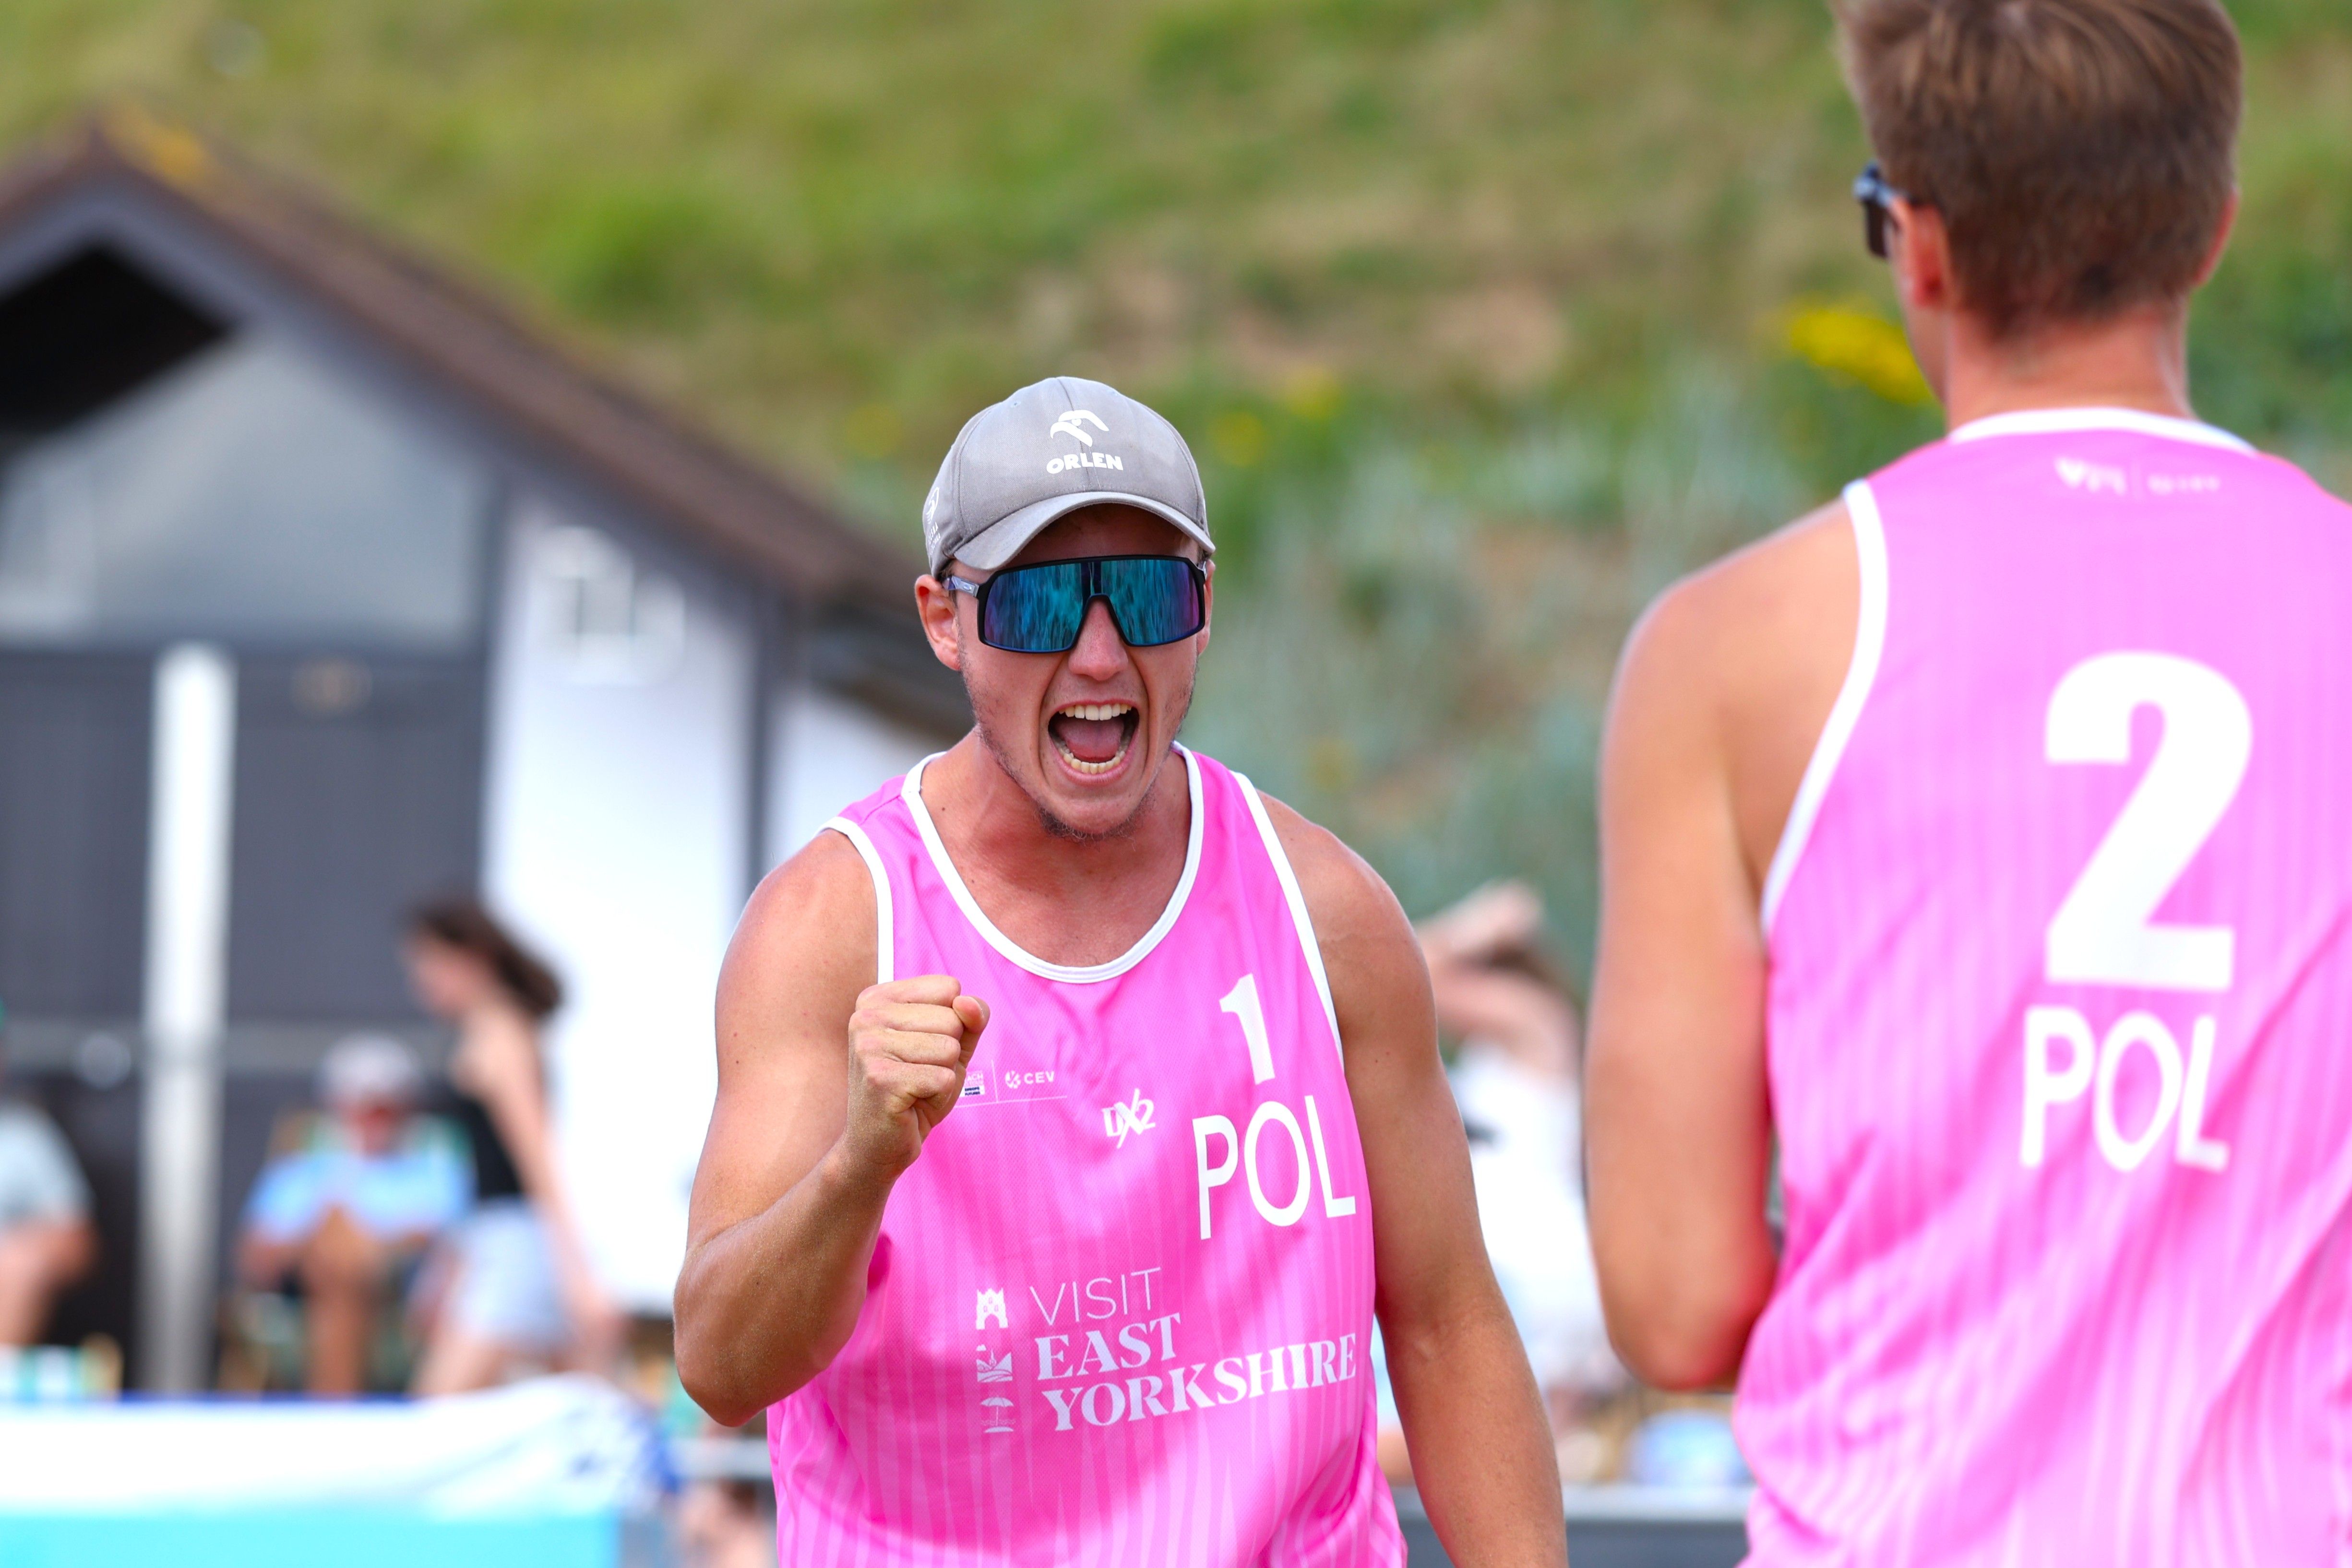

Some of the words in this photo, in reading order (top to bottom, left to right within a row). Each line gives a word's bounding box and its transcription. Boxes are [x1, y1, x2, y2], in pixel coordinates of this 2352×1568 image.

[1046, 452, 1123, 474] ORLEN
[2044, 650, 2253, 989] 2
[1024, 1070, 1055, 1085] CEV
[1219, 973, 1275, 1085] 1
[2019, 1005, 2230, 1174] POL
[1192, 1095, 1356, 1240] POL
[1030, 1266, 1161, 1326] VISIT
[1034, 1313, 1181, 1381] EAST
[1041, 1332, 1357, 1432] YORKSHIRE
